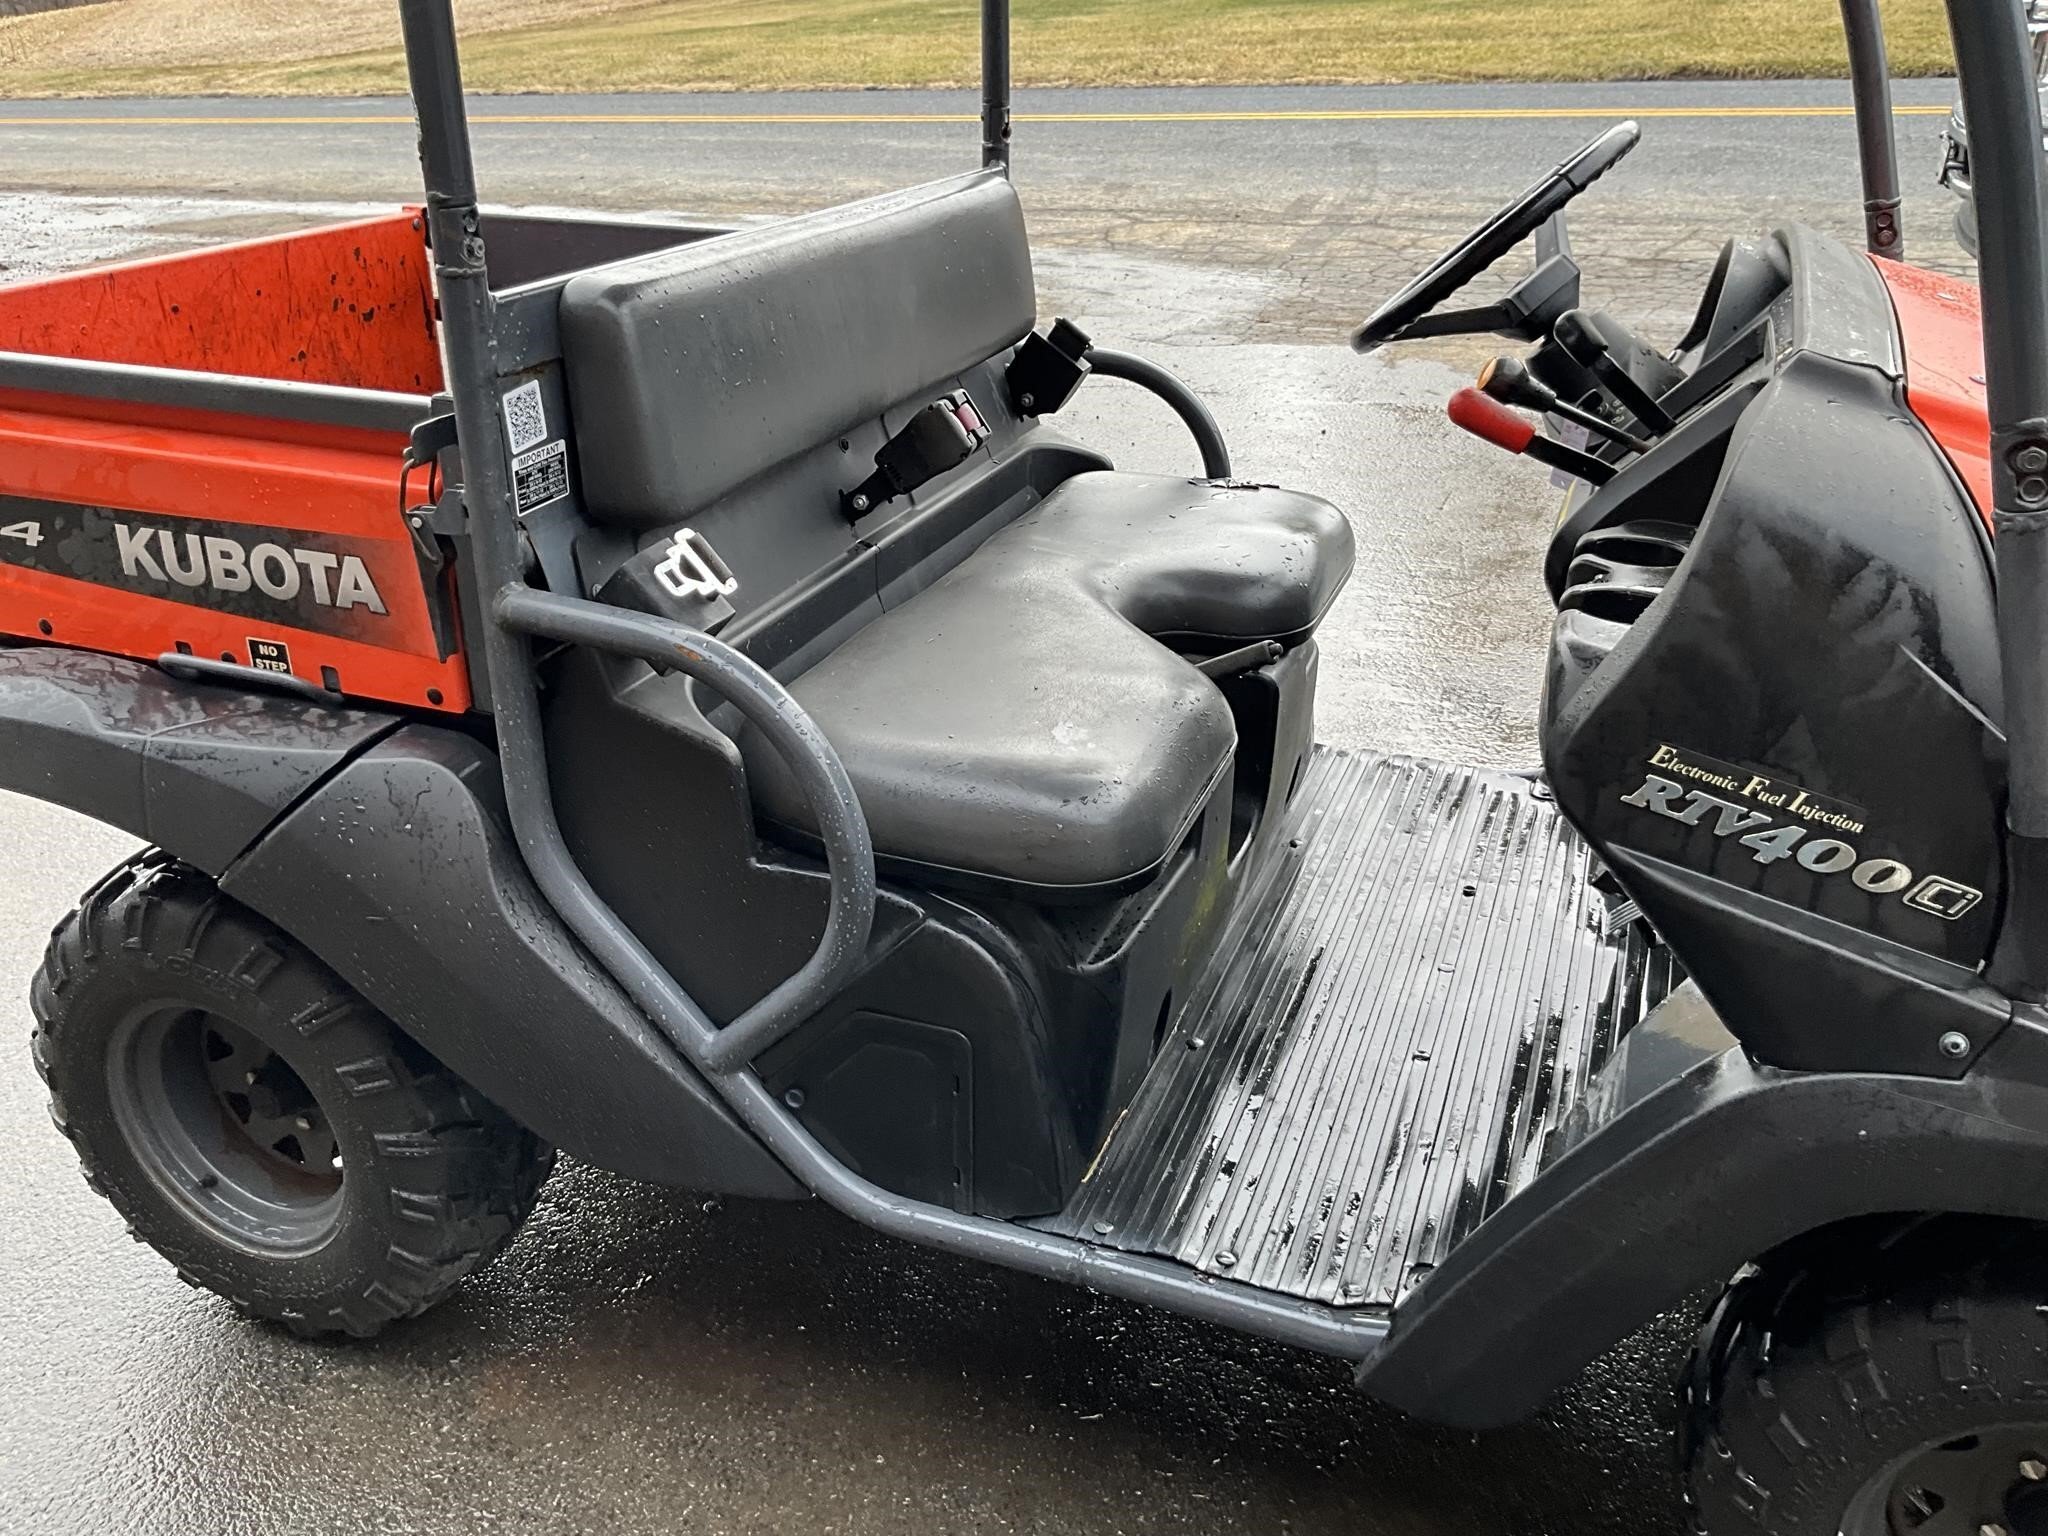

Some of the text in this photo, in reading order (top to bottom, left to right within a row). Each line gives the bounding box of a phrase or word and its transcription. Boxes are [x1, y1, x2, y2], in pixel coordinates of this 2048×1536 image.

[518, 442, 561, 468] IMPORTANT
[114, 523, 388, 614] KUBOTA
[258, 644, 278, 657] NO
[255, 658, 288, 672] STEP
[1647, 744, 1865, 834] Electronic Fuel Injection
